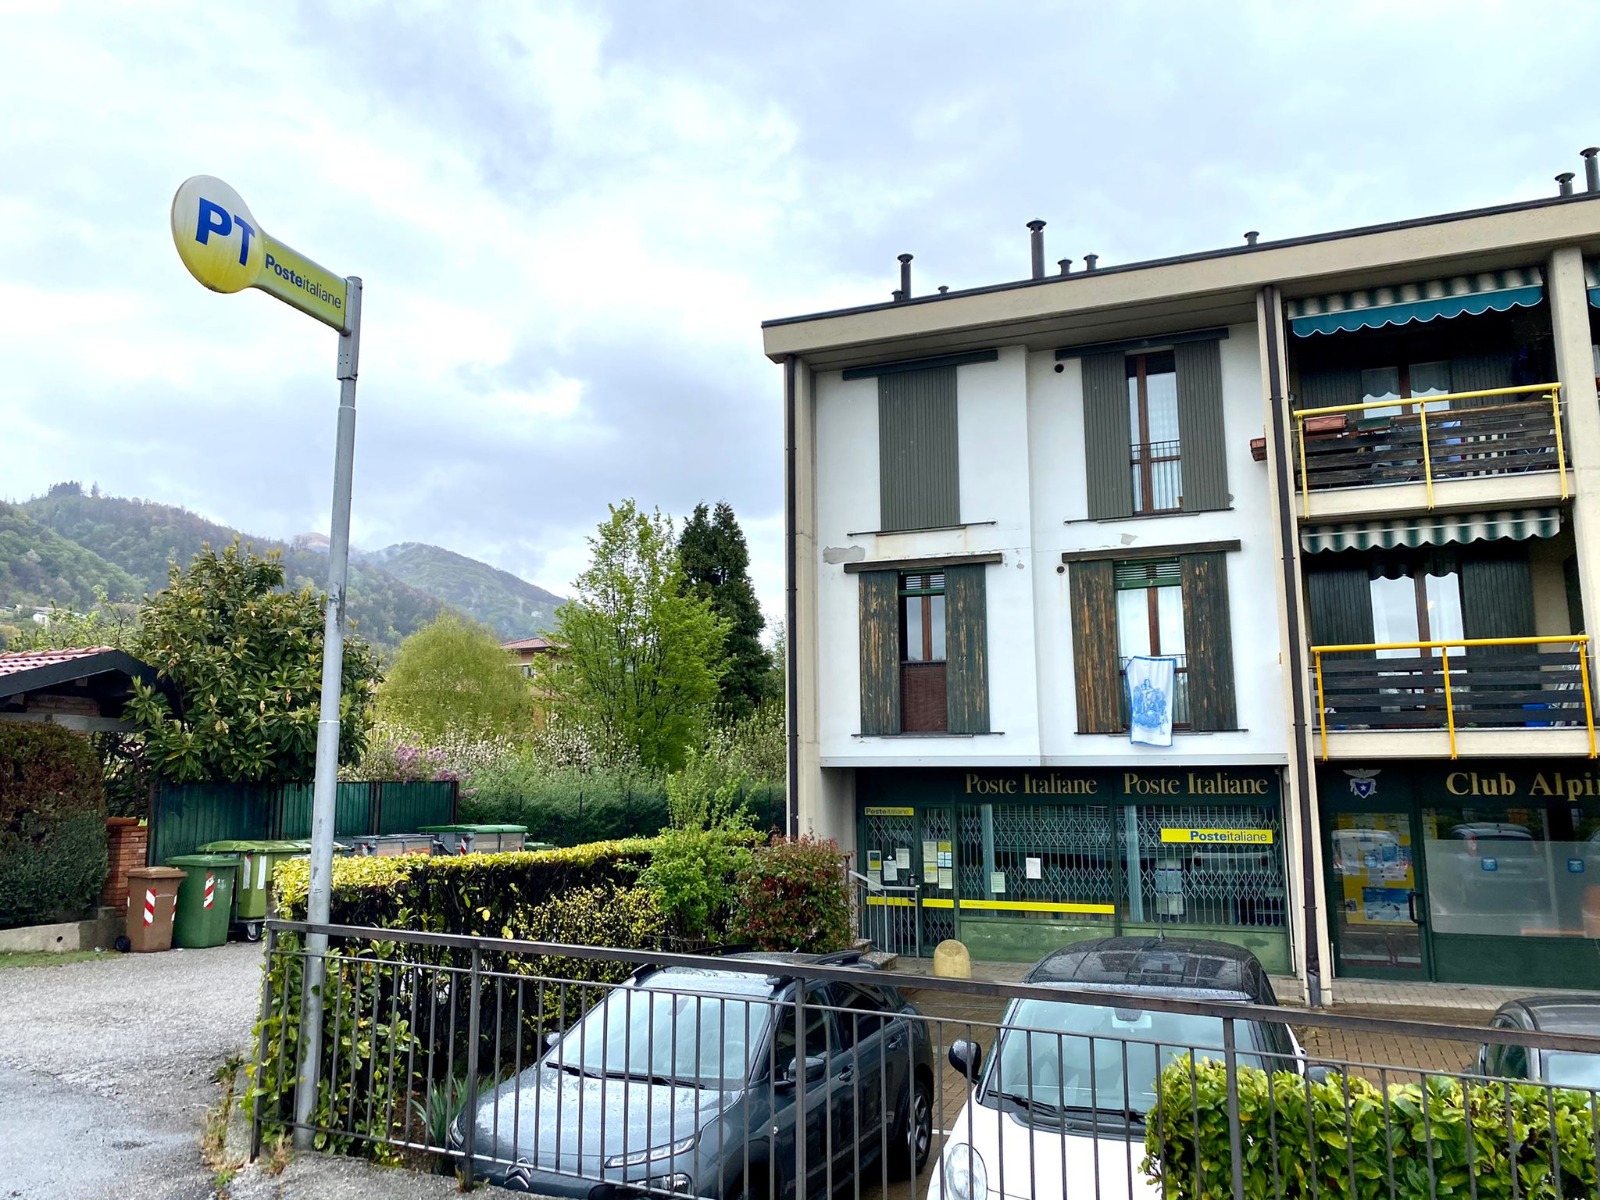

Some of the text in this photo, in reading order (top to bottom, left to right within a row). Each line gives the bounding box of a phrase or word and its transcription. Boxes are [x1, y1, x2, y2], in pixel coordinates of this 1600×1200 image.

[195, 197, 255, 266] PT
[265, 253, 342, 309] Posteitaliane
[965, 773, 1098, 794] Poste Italiane
[1123, 772, 1269, 795] Poste Italiane
[1446, 772, 1600, 802] Club Alpi
[1190, 830, 1267, 842] Posteitaliane
